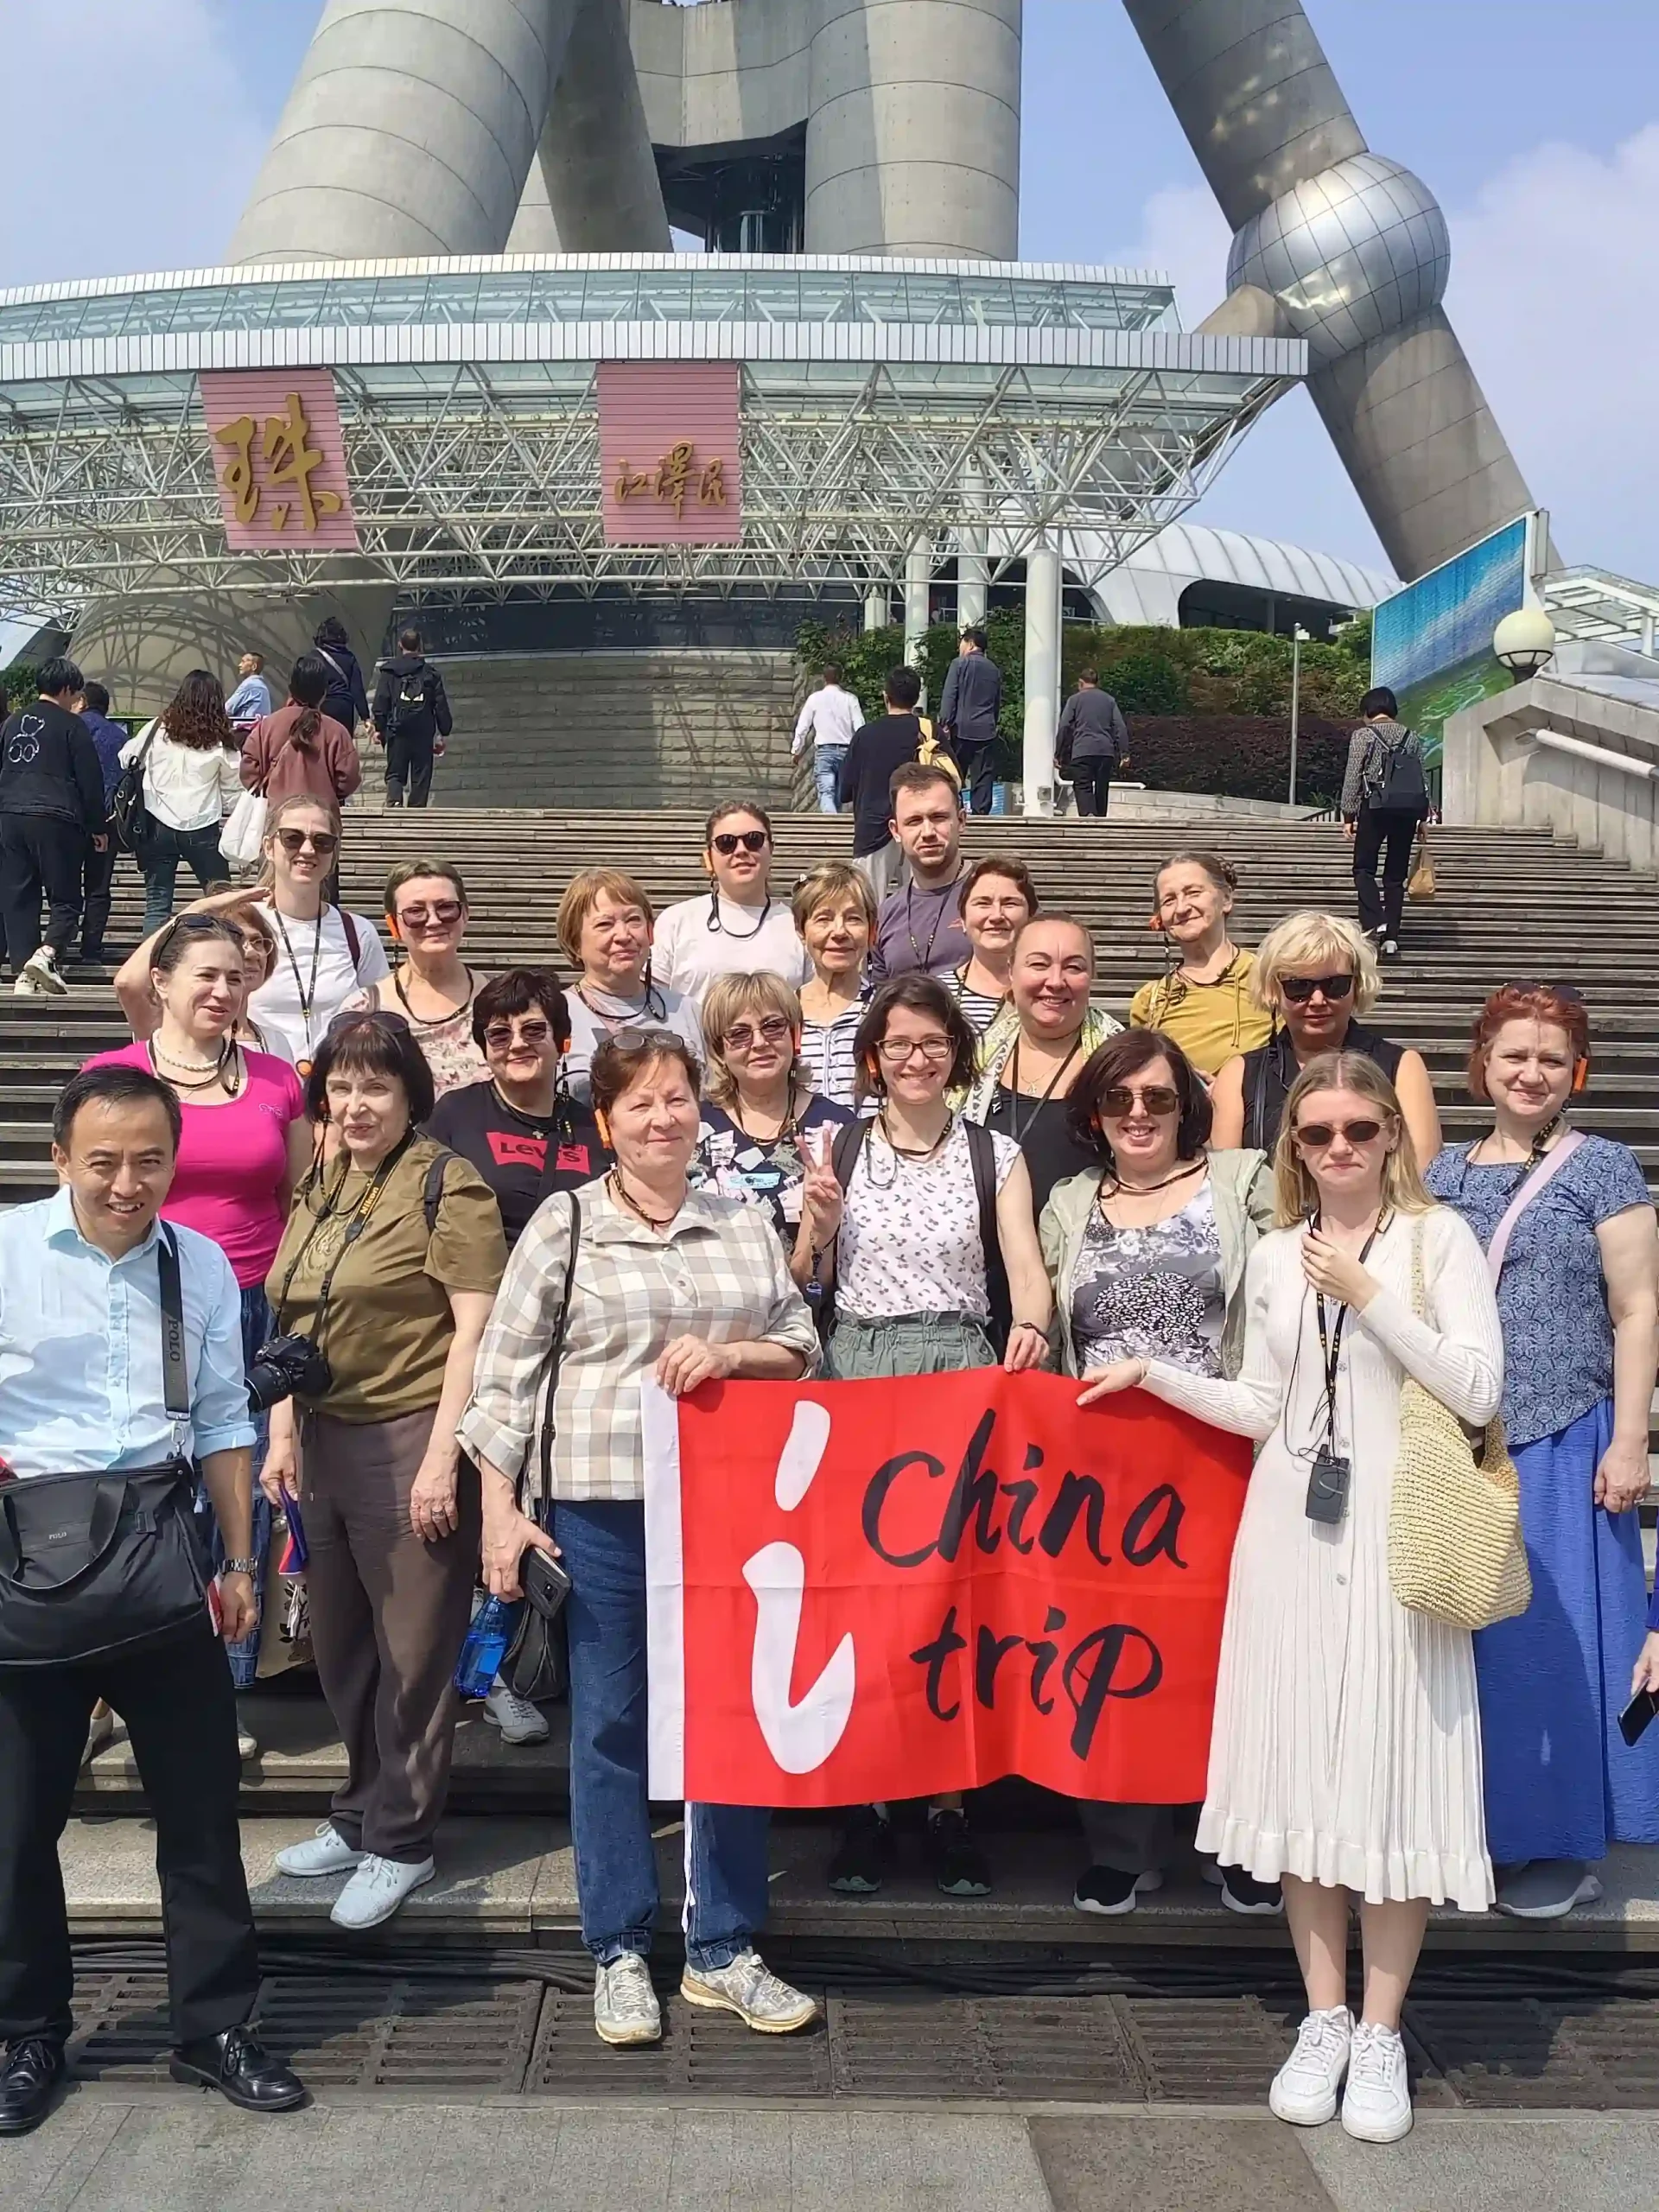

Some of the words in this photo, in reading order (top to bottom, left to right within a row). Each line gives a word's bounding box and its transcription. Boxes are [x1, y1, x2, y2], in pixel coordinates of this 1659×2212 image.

[359, 1186, 379, 1215] Nikon
[168, 1319, 181, 1363] POLO
[861, 1408, 1189, 1569] China
[910, 1605, 1163, 1761] trip
